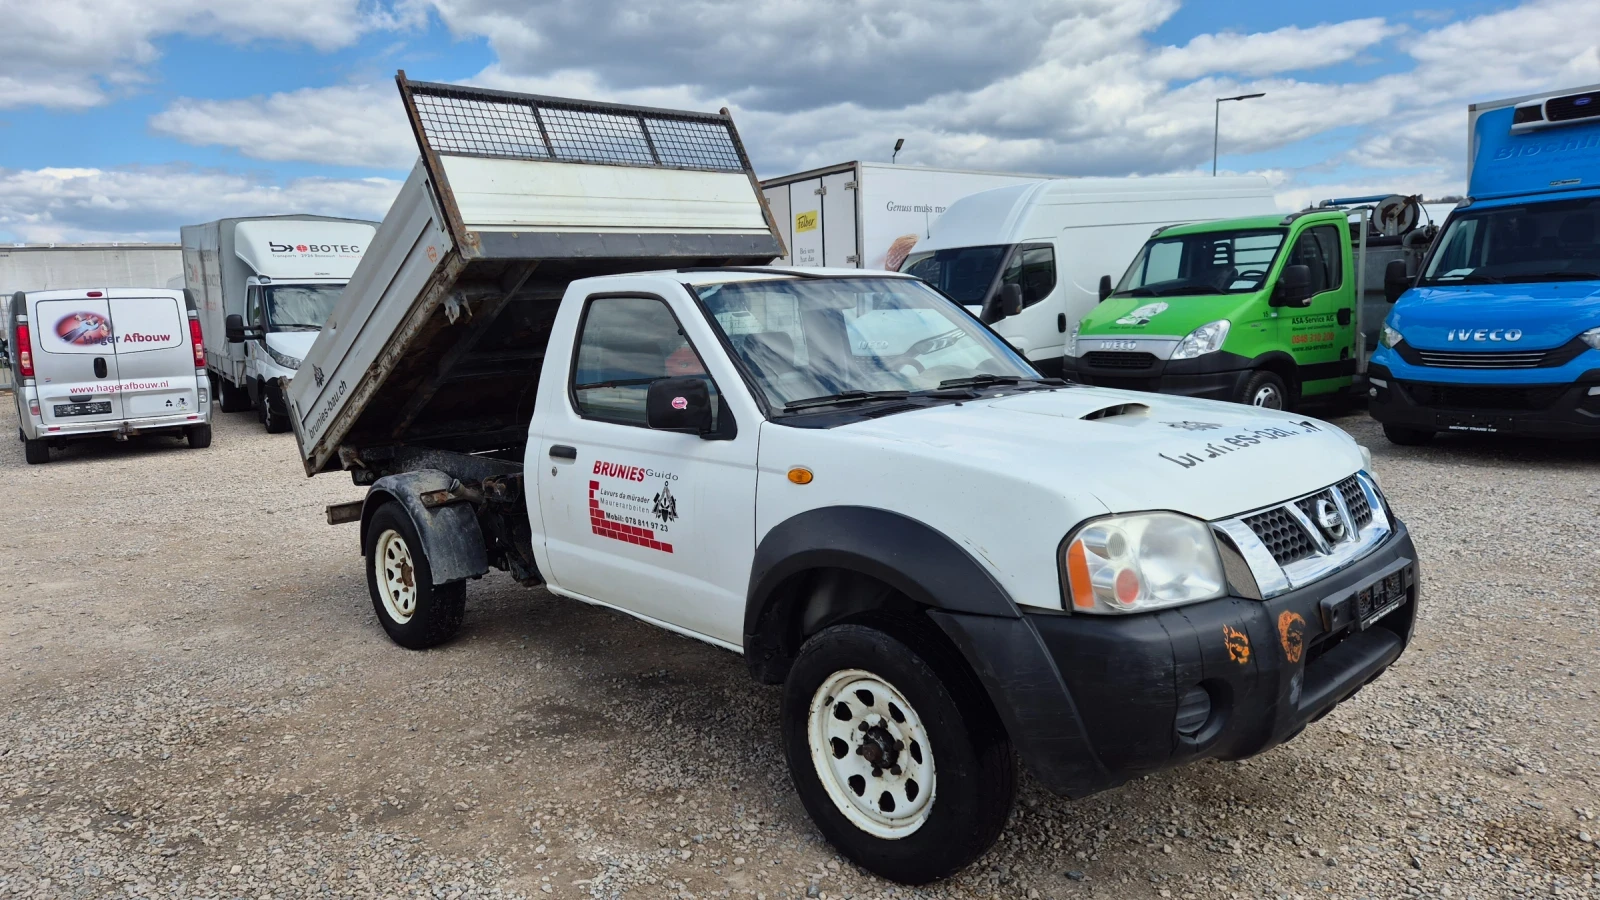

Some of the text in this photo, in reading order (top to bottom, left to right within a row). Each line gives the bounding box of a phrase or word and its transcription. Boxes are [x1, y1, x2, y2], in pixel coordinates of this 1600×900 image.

[886, 200, 912, 213] Genuss
[913, 205, 933, 213] muss
[797, 214, 816, 230] Felber
[309, 244, 360, 253] BOTEC
[1291, 314, 1335, 325] ASA-Service AG
[83, 332, 171, 346] Hager Afbouw
[1447, 328, 1523, 342] IVECO
[1100, 340, 1137, 350] IVECO
[69, 380, 169, 395] www.hagerafbouw.nl
[307, 379, 348, 440] brunies-bau.ch
[592, 460, 679, 482] BRUNIES Guido
[600, 488, 619, 498] Lavurs
[626, 493, 650, 504] mürader
[599, 497, 650, 514] Maurerarbeiten
[605, 512, 669, 533] Mobil: 078 811 97 23
